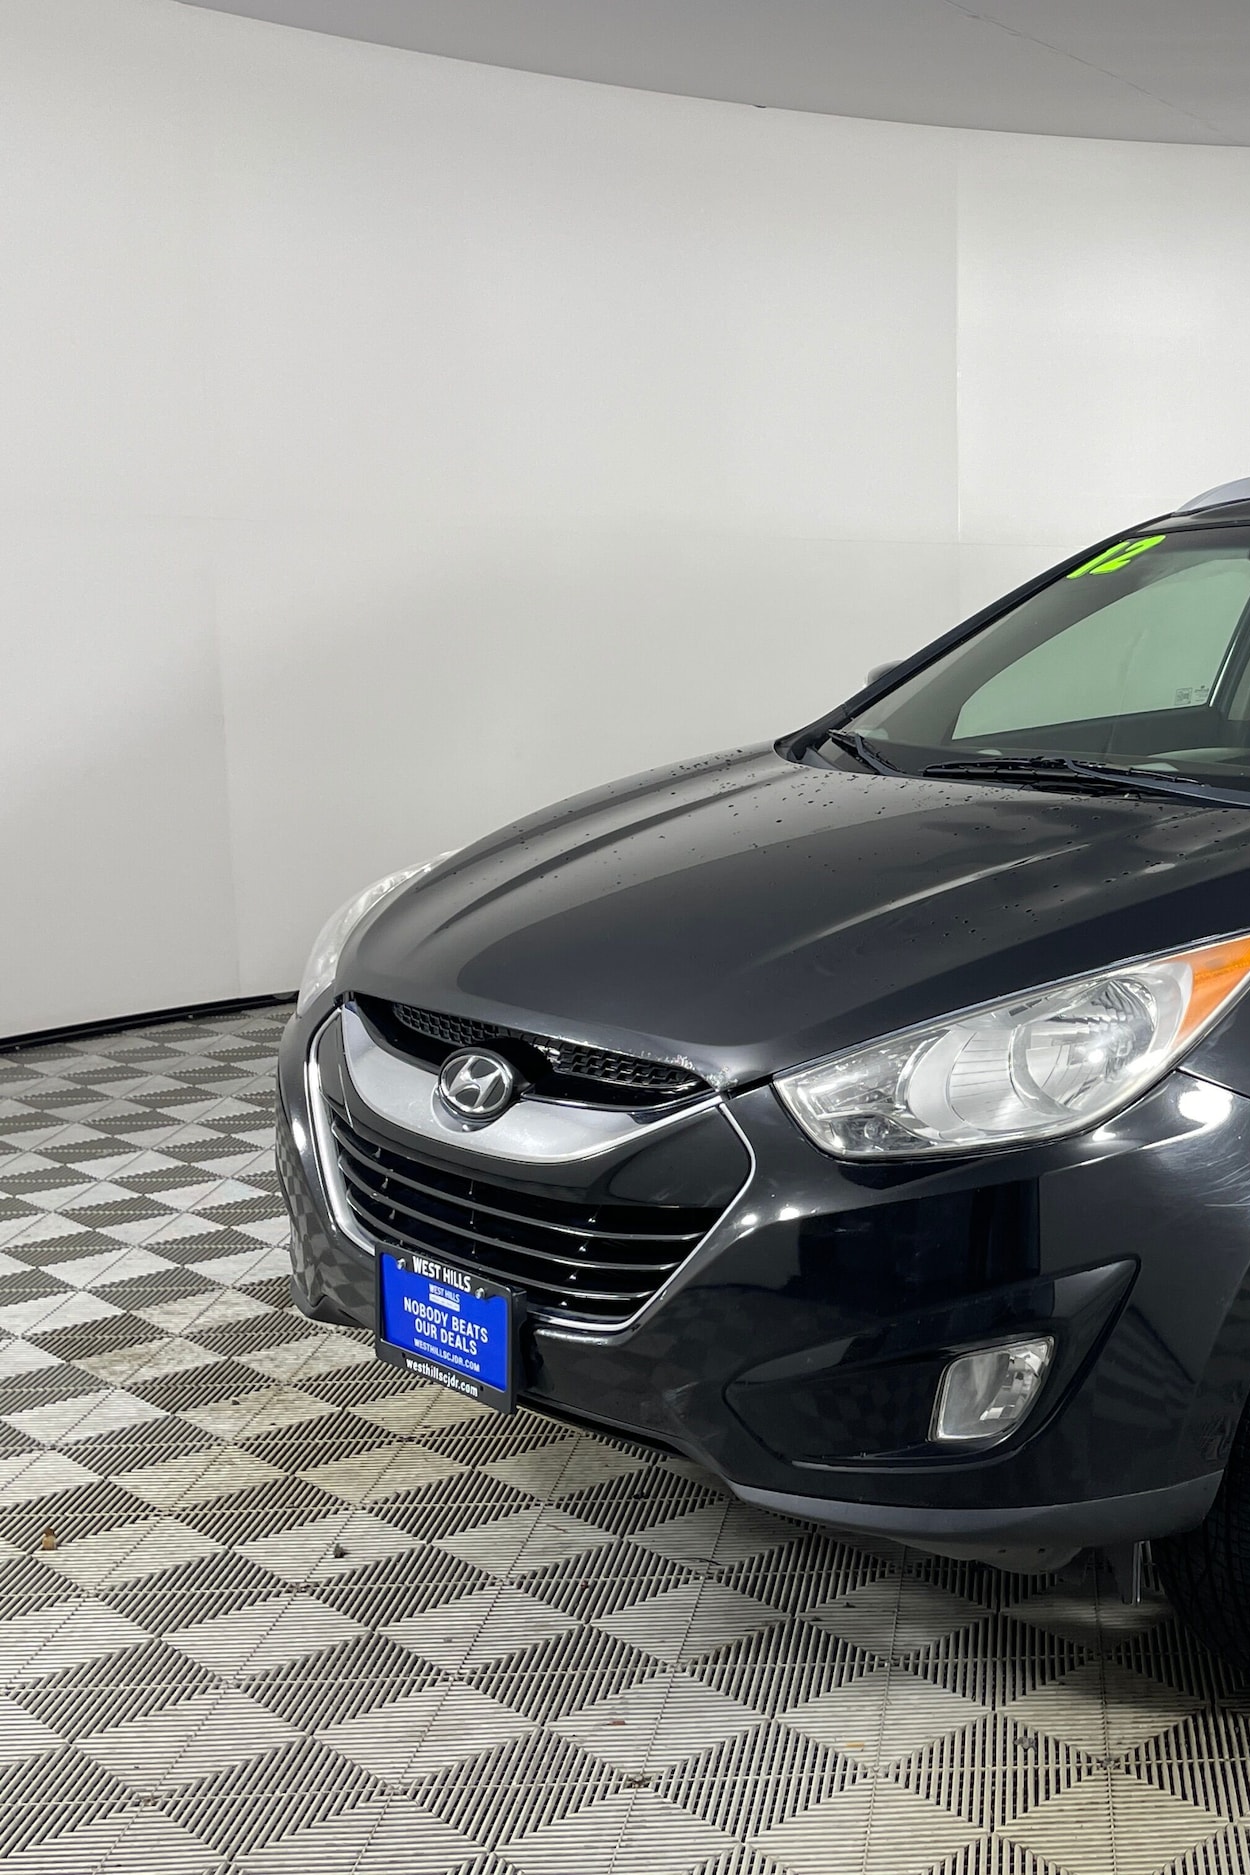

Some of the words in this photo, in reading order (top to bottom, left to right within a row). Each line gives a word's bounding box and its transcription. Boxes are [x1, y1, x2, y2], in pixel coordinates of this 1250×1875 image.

[1066, 535, 1166, 579] 12
[412, 1255, 441, 1280] WEST
[443, 1267, 471, 1293] HILLS
[428, 1283, 445, 1297] WEST
[445, 1289, 460, 1303] HILLS
[403, 1296, 449, 1328] NOBODY
[451, 1316, 488, 1343] BEATS
[414, 1317, 438, 1340] OUR
[440, 1328, 477, 1355] DEALS
[413, 1337, 480, 1373] WESTHILLSCJDR.COM
[406, 1358, 478, 1397] westhillscjdr.com
